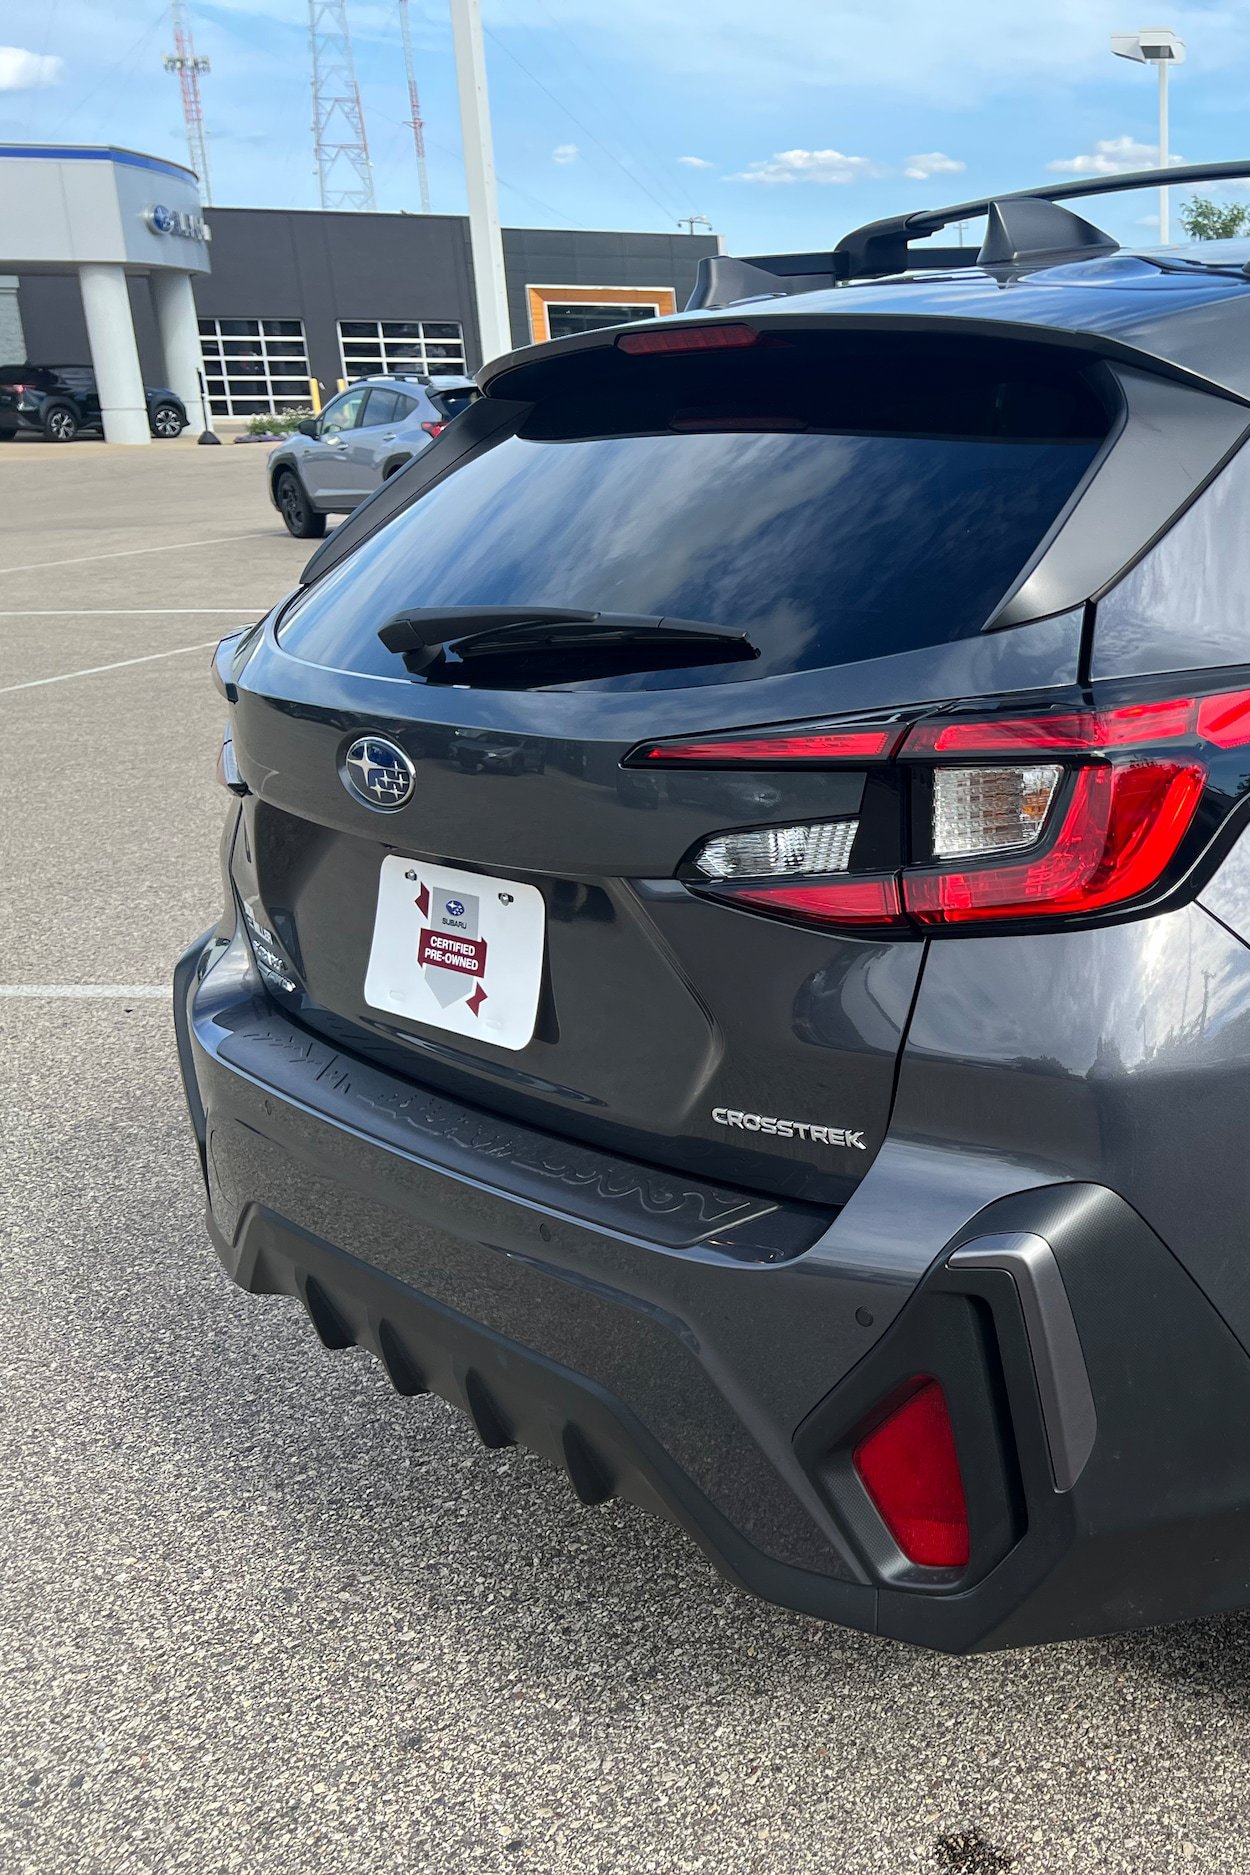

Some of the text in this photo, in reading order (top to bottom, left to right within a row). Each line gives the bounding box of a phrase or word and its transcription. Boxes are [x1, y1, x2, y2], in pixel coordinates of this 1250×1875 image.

[442, 917, 467, 930] SUBARU
[430, 936, 476, 957] CERTIFIED
[424, 947, 479, 971] PRE-OWNED
[711, 1106, 867, 1151] CROSSTREK
